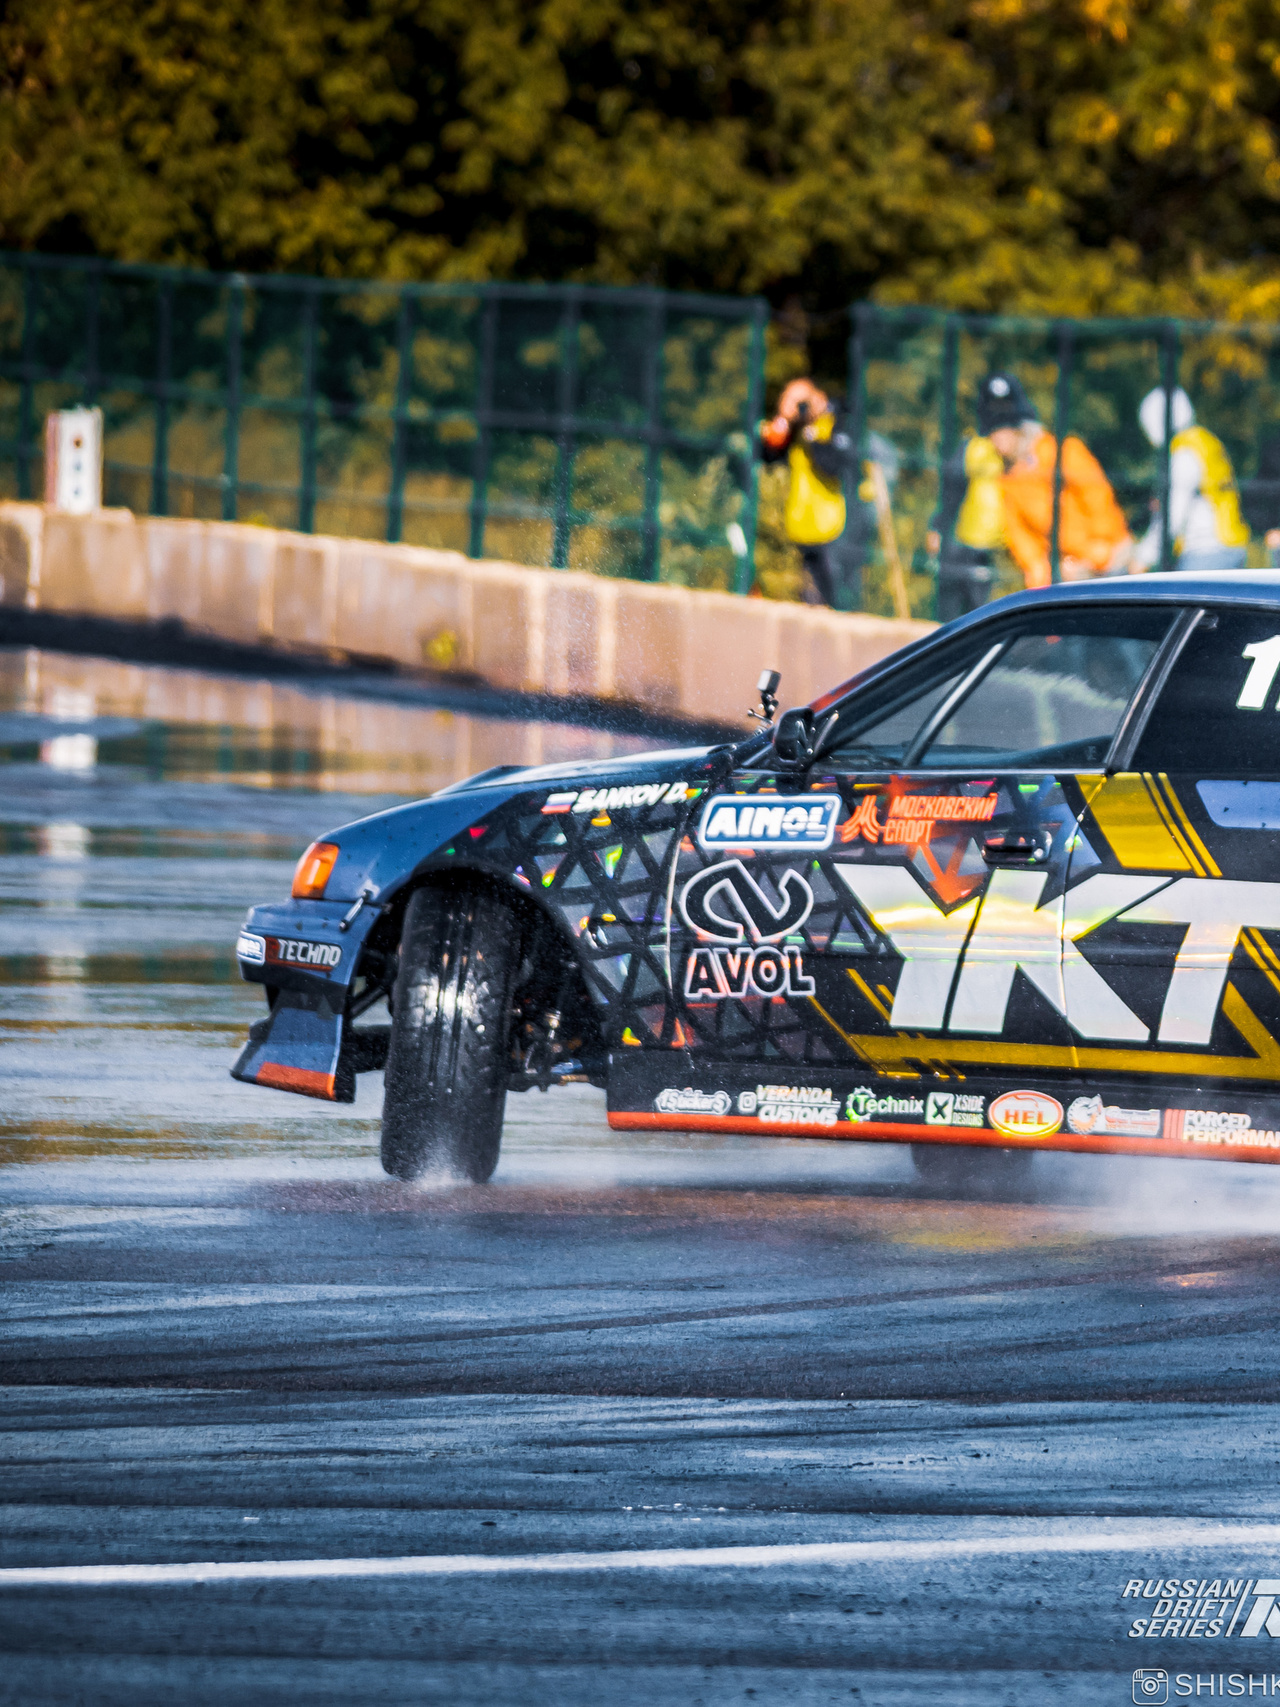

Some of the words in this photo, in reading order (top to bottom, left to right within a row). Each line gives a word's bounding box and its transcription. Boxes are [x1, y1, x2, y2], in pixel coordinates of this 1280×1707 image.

[572, 782, 671, 814] SANKOV
[663, 781, 689, 805] D.
[888, 792, 999, 821] МОСКОВСКИЙ
[705, 805, 828, 838] AIMOL
[883, 818, 935, 844] СПОРТ
[277, 937, 342, 967] TECHNO
[684, 945, 816, 998] AVOL
[857, 1094, 925, 1113] Technix
[953, 1094, 985, 1112] XSIDE
[758, 1105, 839, 1126] CUSTOMS
[953, 1110, 984, 1126] DESIGNS
[1003, 1108, 1049, 1126] HEL
[1183, 1109, 1252, 1130] FORCED
